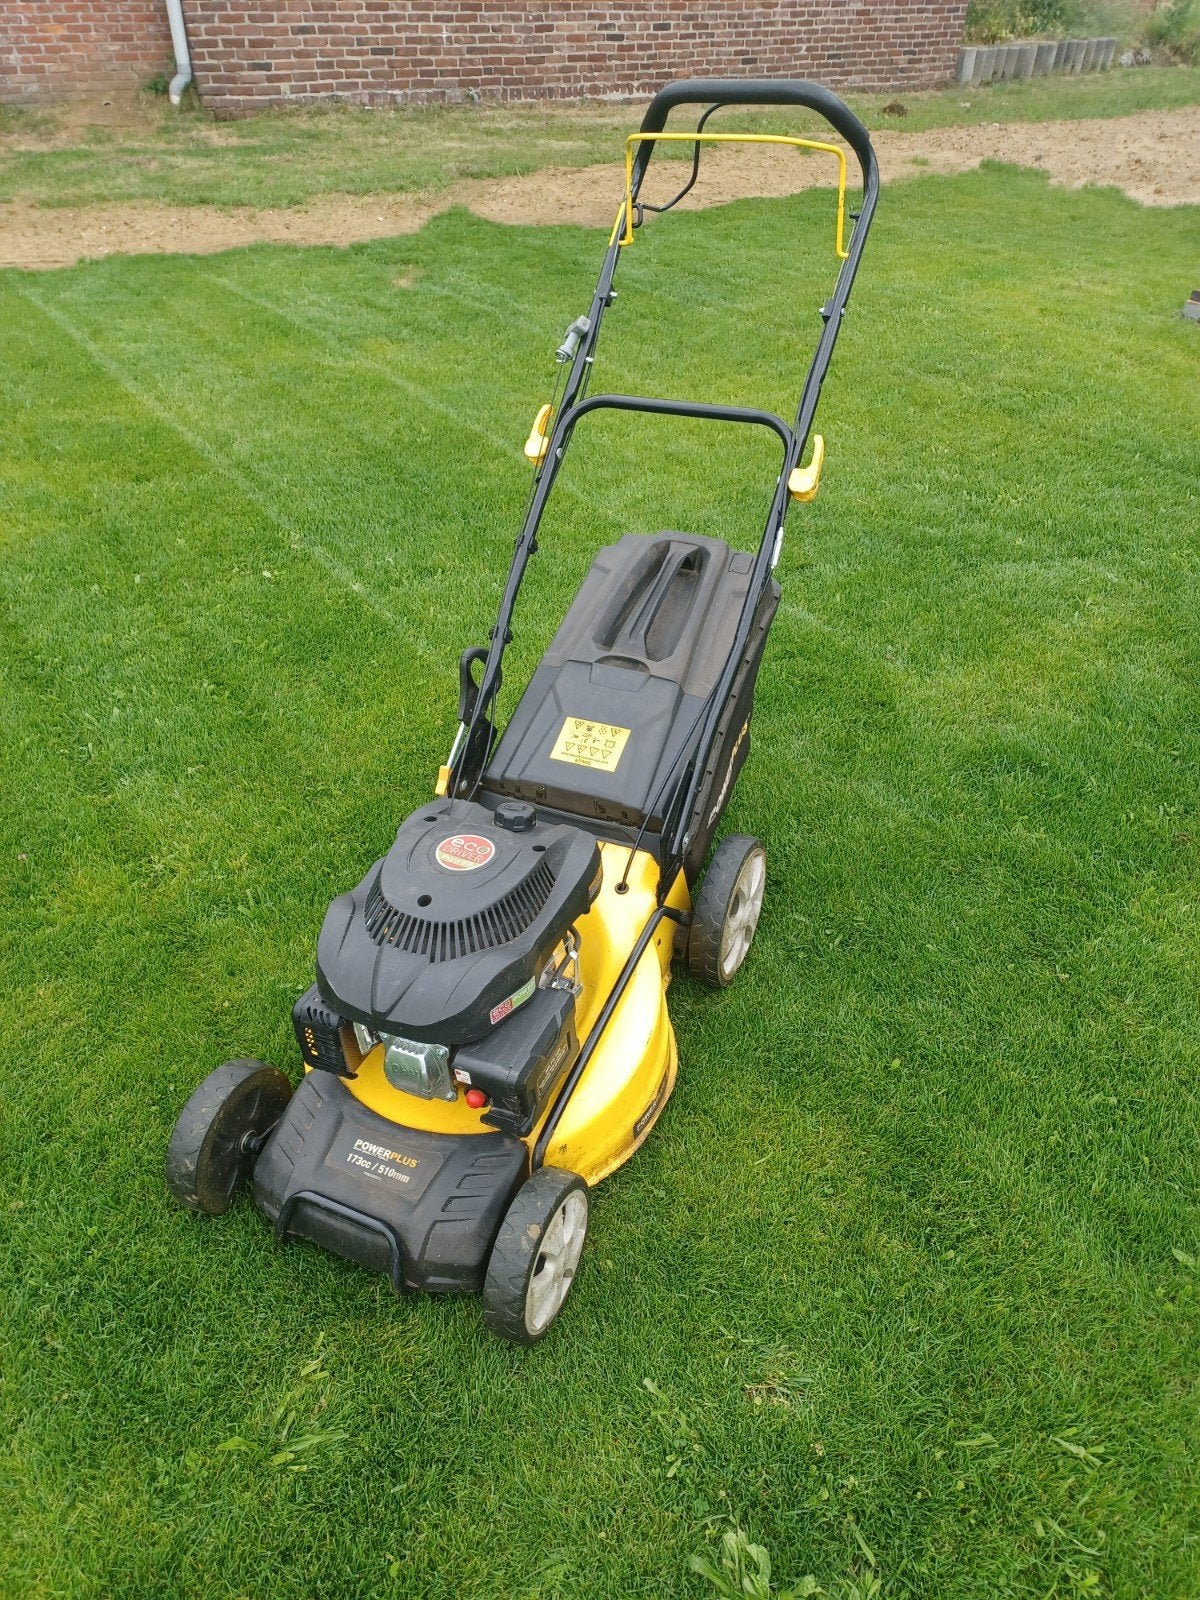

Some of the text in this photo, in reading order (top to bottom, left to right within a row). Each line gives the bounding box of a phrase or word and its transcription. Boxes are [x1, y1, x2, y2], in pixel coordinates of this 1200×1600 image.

[441, 844, 484, 863] DRIVER
[451, 838, 490, 855] eco
[354, 1138, 419, 1168] POWERPLUS
[346, 1153, 372, 1169] 173cc
[371, 1162, 379, 1171] /
[377, 1164, 411, 1184] 510mm
